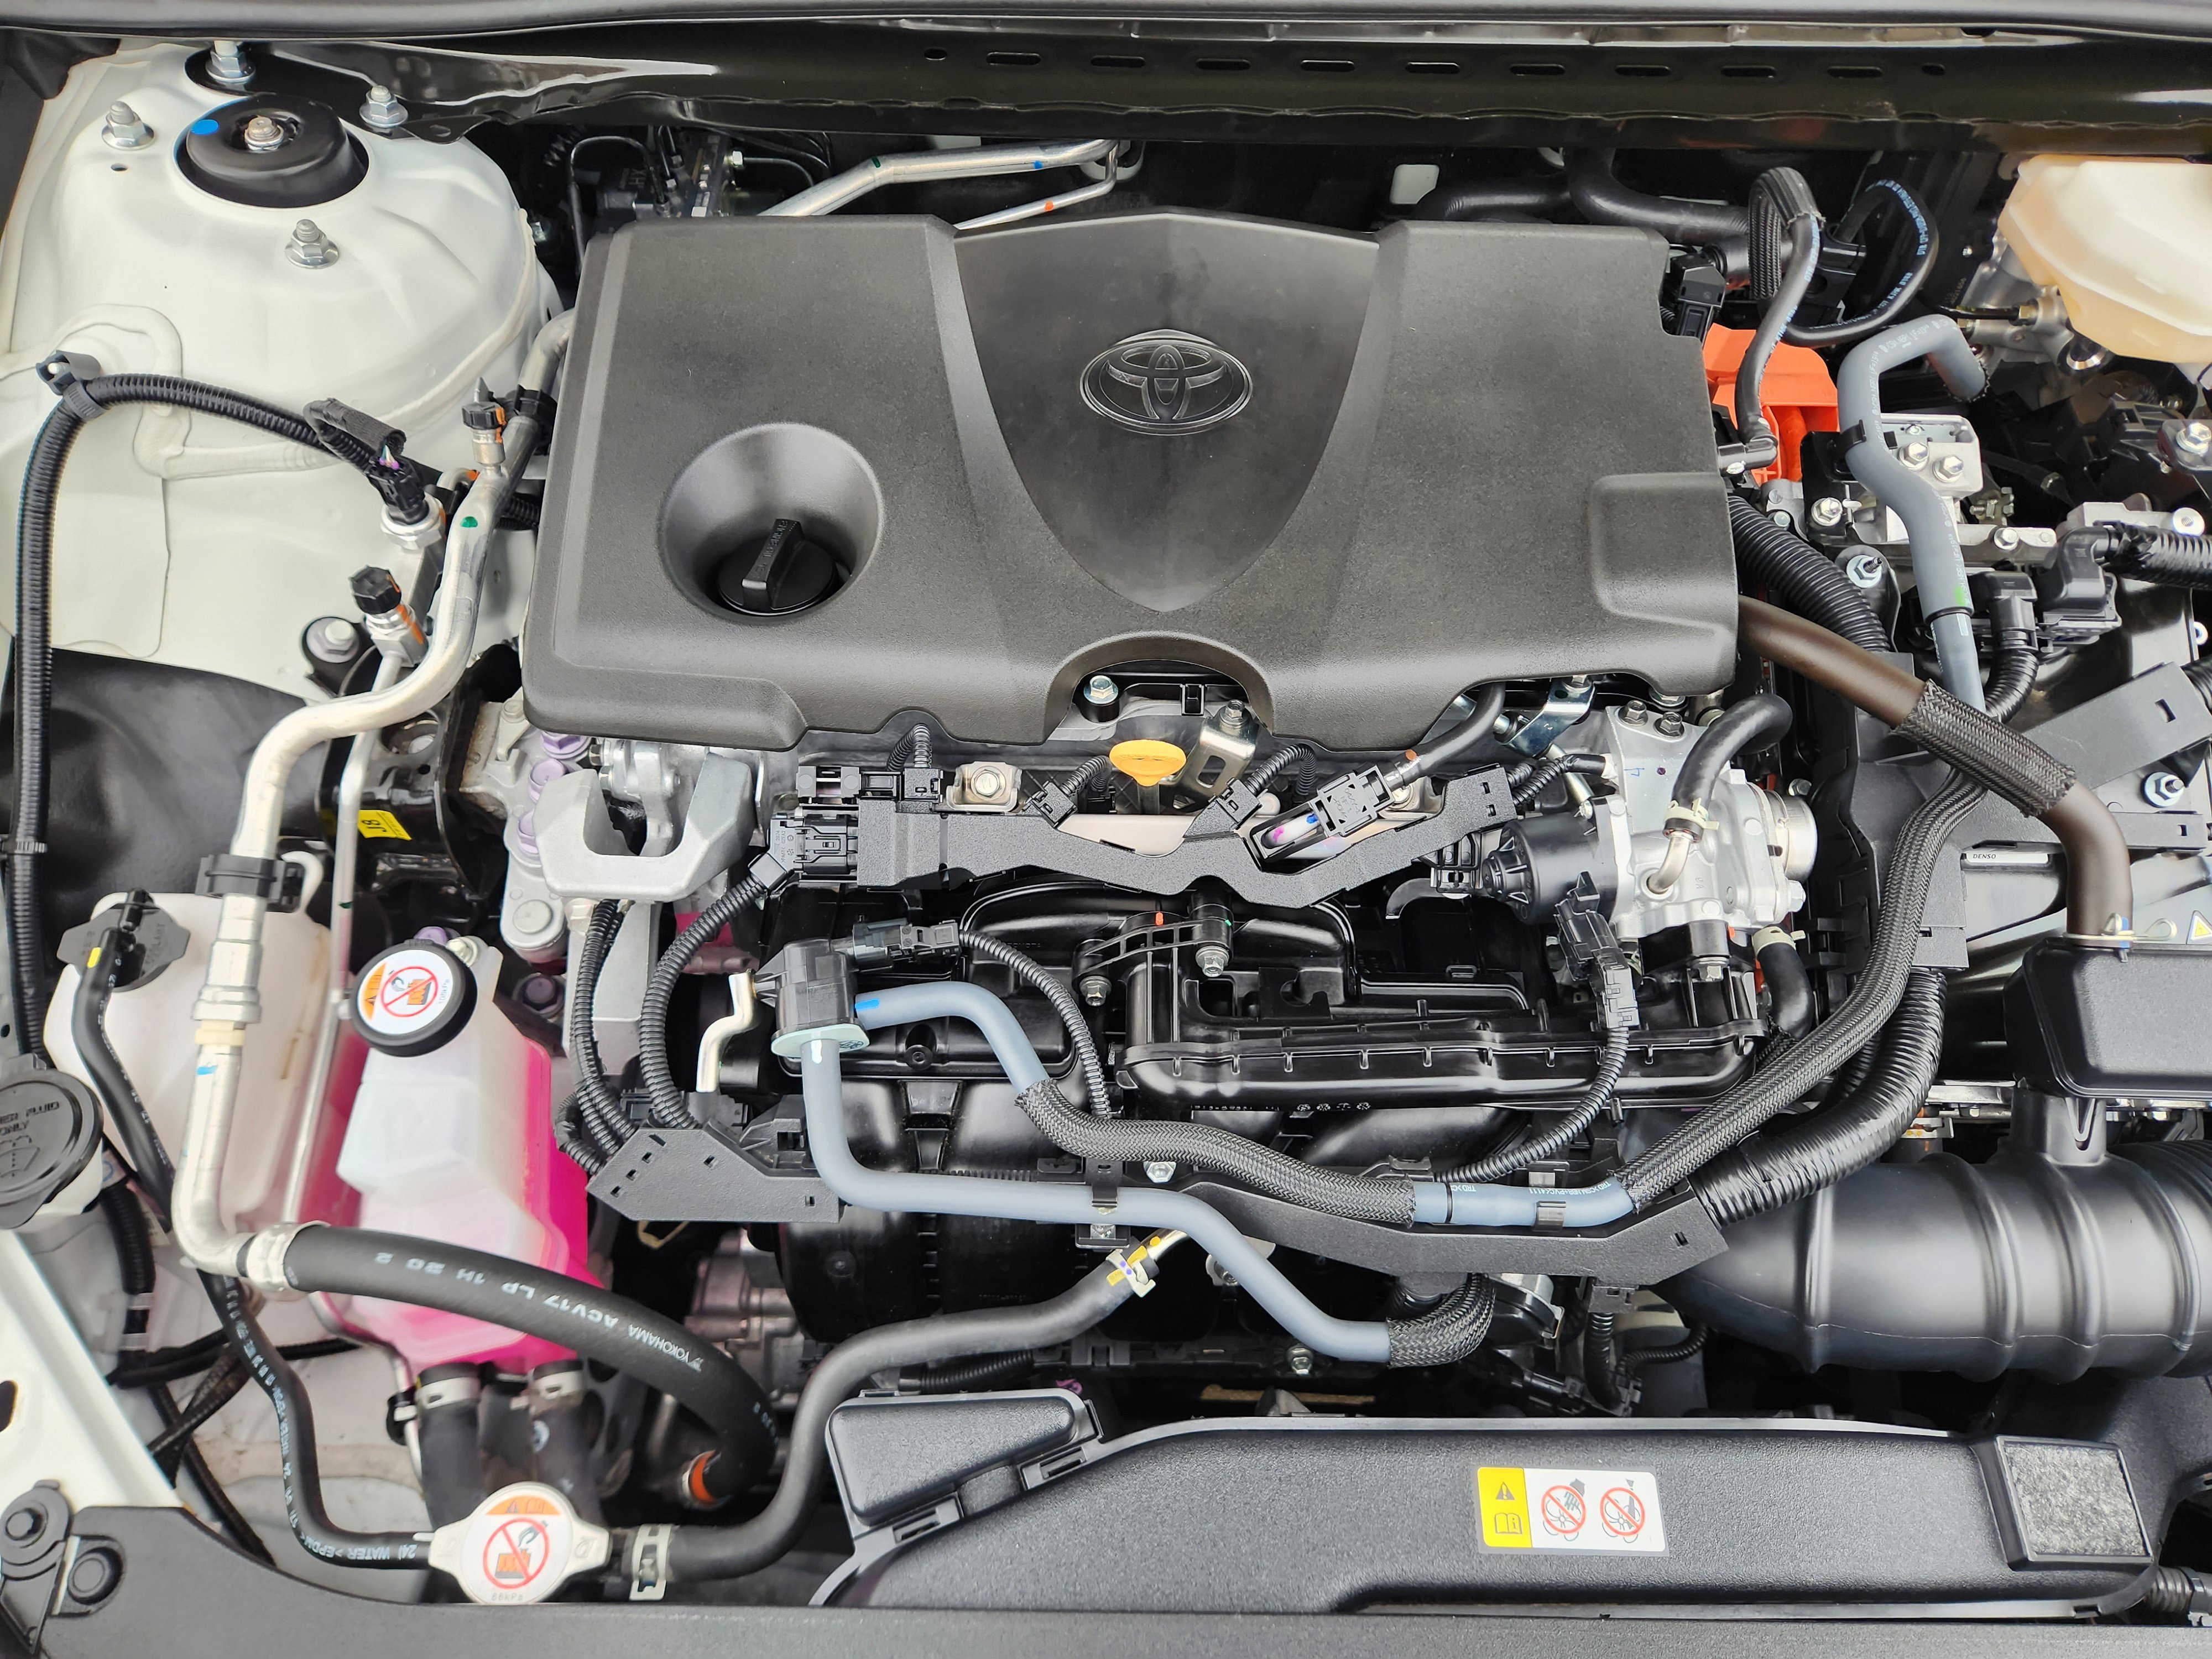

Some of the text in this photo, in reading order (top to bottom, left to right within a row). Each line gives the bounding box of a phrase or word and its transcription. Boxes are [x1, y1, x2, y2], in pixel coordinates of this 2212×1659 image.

[437, 978, 451, 1005] 108kPa
[25, 1100, 61, 1118] FLUID
[374, 1251, 691, 1364] YOKOHAMA ACV17 LP 1H 20 2
[299, 1533, 345, 1559] >EPDM<
[347, 1546, 390, 1560] WATER
[491, 1593, 523, 1602] 88kPa
